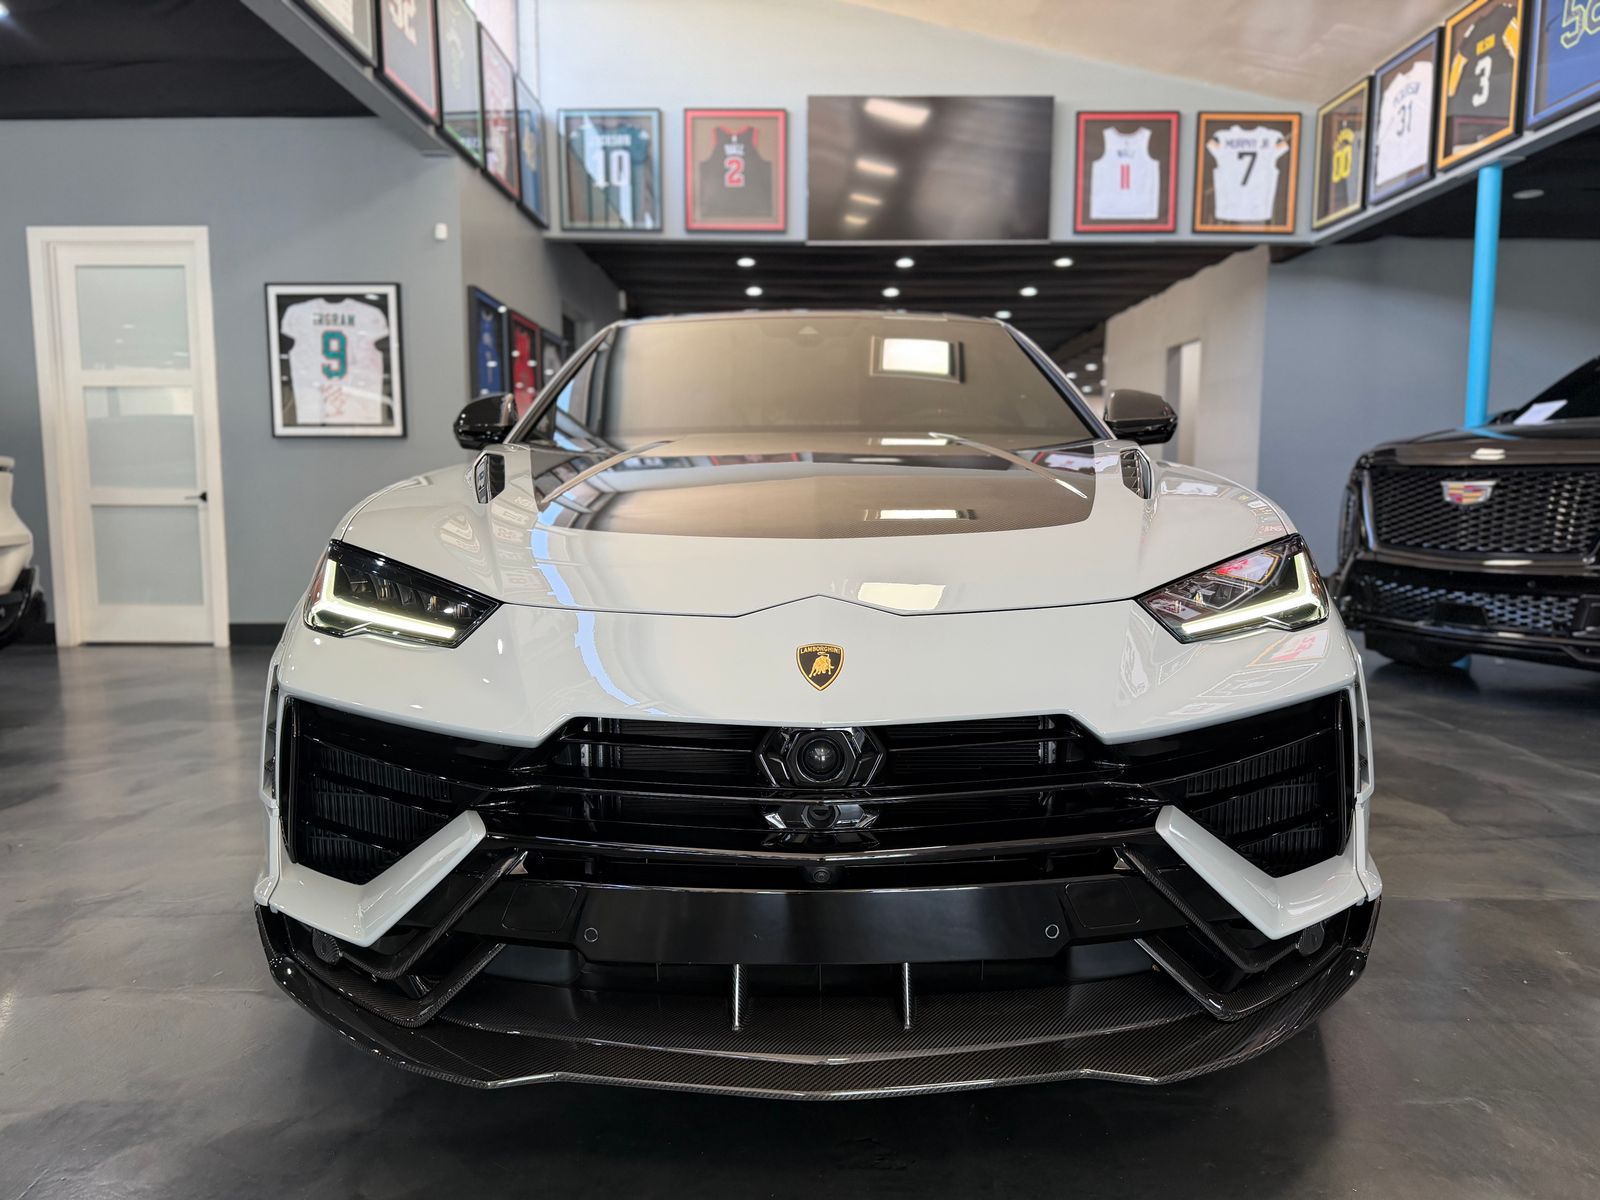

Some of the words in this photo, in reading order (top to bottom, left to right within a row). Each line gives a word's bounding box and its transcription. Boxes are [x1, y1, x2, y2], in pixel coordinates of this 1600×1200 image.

[1472, 55, 1493, 107] 3
[1396, 100, 1413, 137] 31
[592, 148, 632, 188] 10
[724, 155, 746, 188] 2
[1237, 151, 1258, 187] 7
[320, 329, 348, 380] 9
[800, 645, 841, 654] LAMBORGHINI
